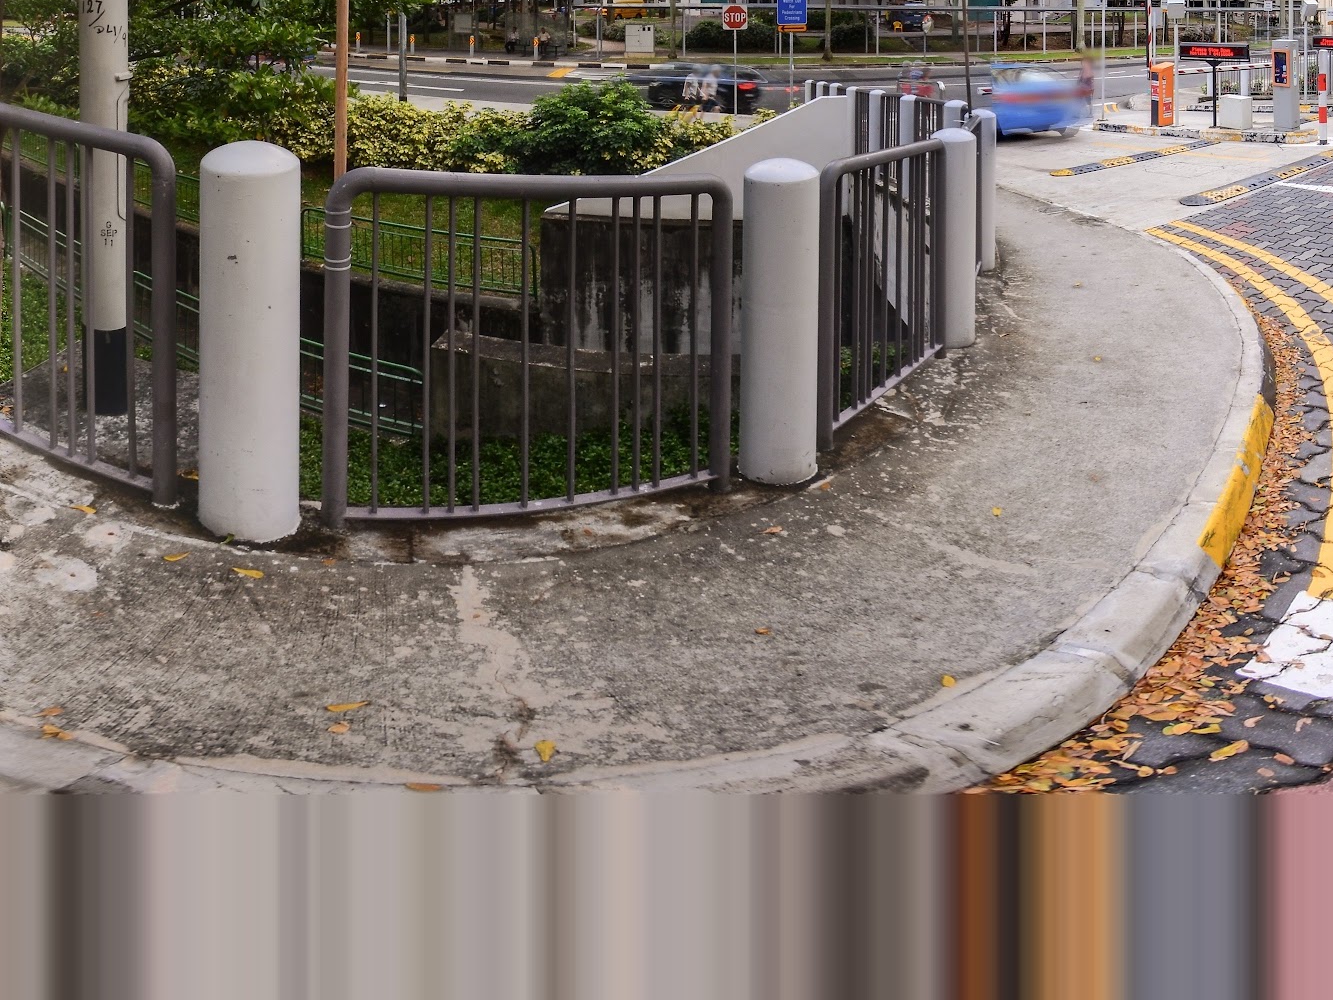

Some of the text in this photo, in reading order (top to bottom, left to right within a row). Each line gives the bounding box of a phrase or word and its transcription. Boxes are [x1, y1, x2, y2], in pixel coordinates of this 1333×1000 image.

[724, 12, 746, 23] STOP
[105, 220, 112, 229] G
[100, 229, 118, 237] SEP
[104, 238, 113, 246] 11
